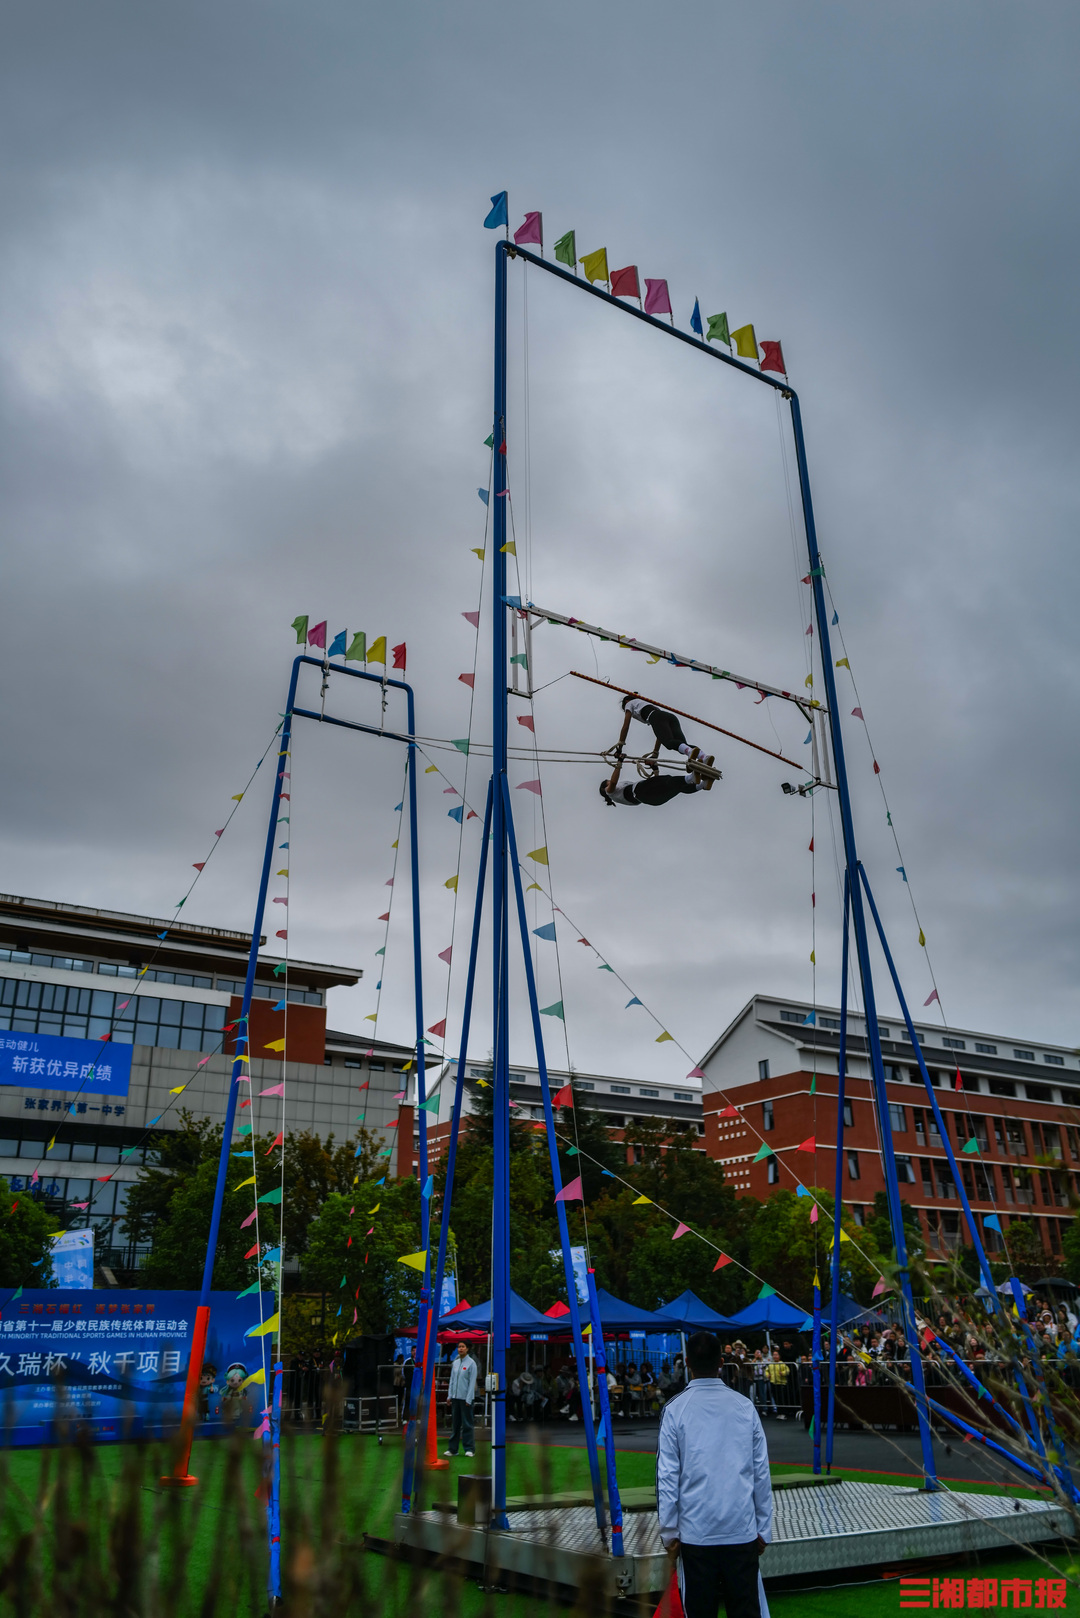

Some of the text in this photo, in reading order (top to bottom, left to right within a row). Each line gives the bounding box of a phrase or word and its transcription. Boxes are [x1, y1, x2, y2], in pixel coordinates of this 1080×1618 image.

[11, 1055, 112, 1082] 斩获优异成绩
[24, 1097, 125, 1117] 张家界市第一中学
[18, 1303, 155, 1314] 三湘石榴红 逐梦张家界
[0, 1319, 189, 1332] 省第十一届少数民族传统体育运动会
